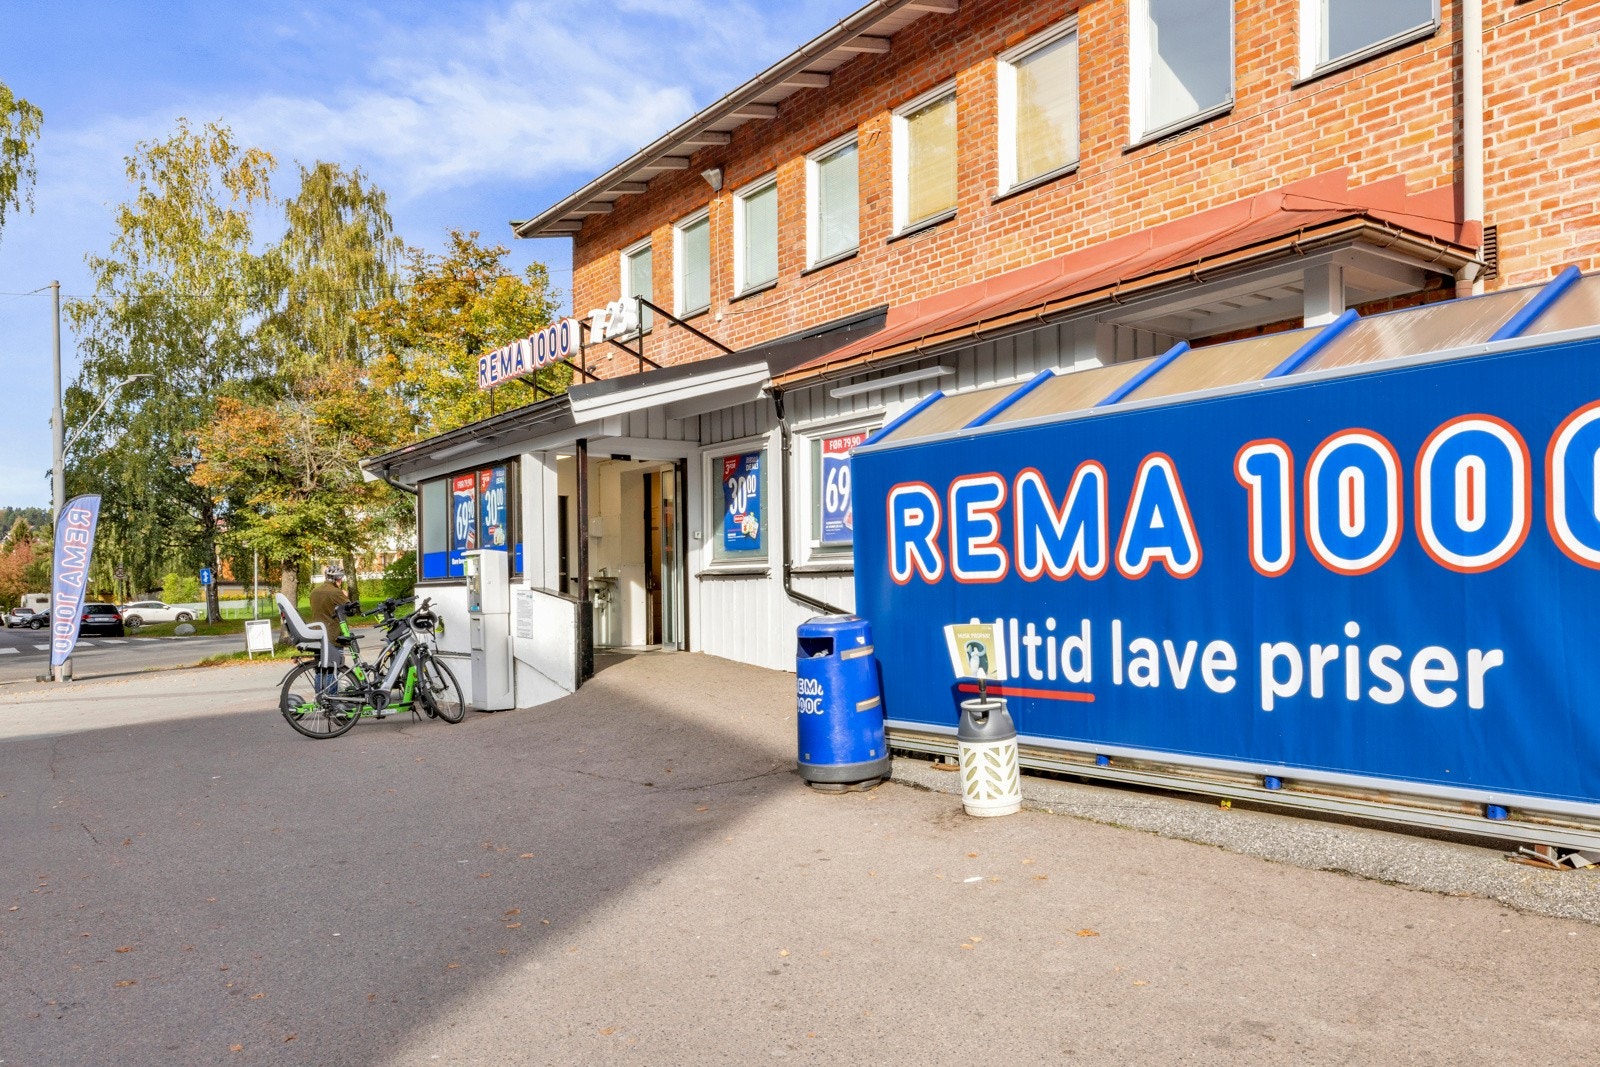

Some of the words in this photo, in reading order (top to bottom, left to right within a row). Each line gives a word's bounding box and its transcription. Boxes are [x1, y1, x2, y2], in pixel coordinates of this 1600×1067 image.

[478, 339, 526, 389] REMA
[528, 317, 571, 370] 1000
[887, 452, 1202, 585] REMA
[1111, 618, 1238, 694] lave
[1260, 621, 1504, 711] priser
